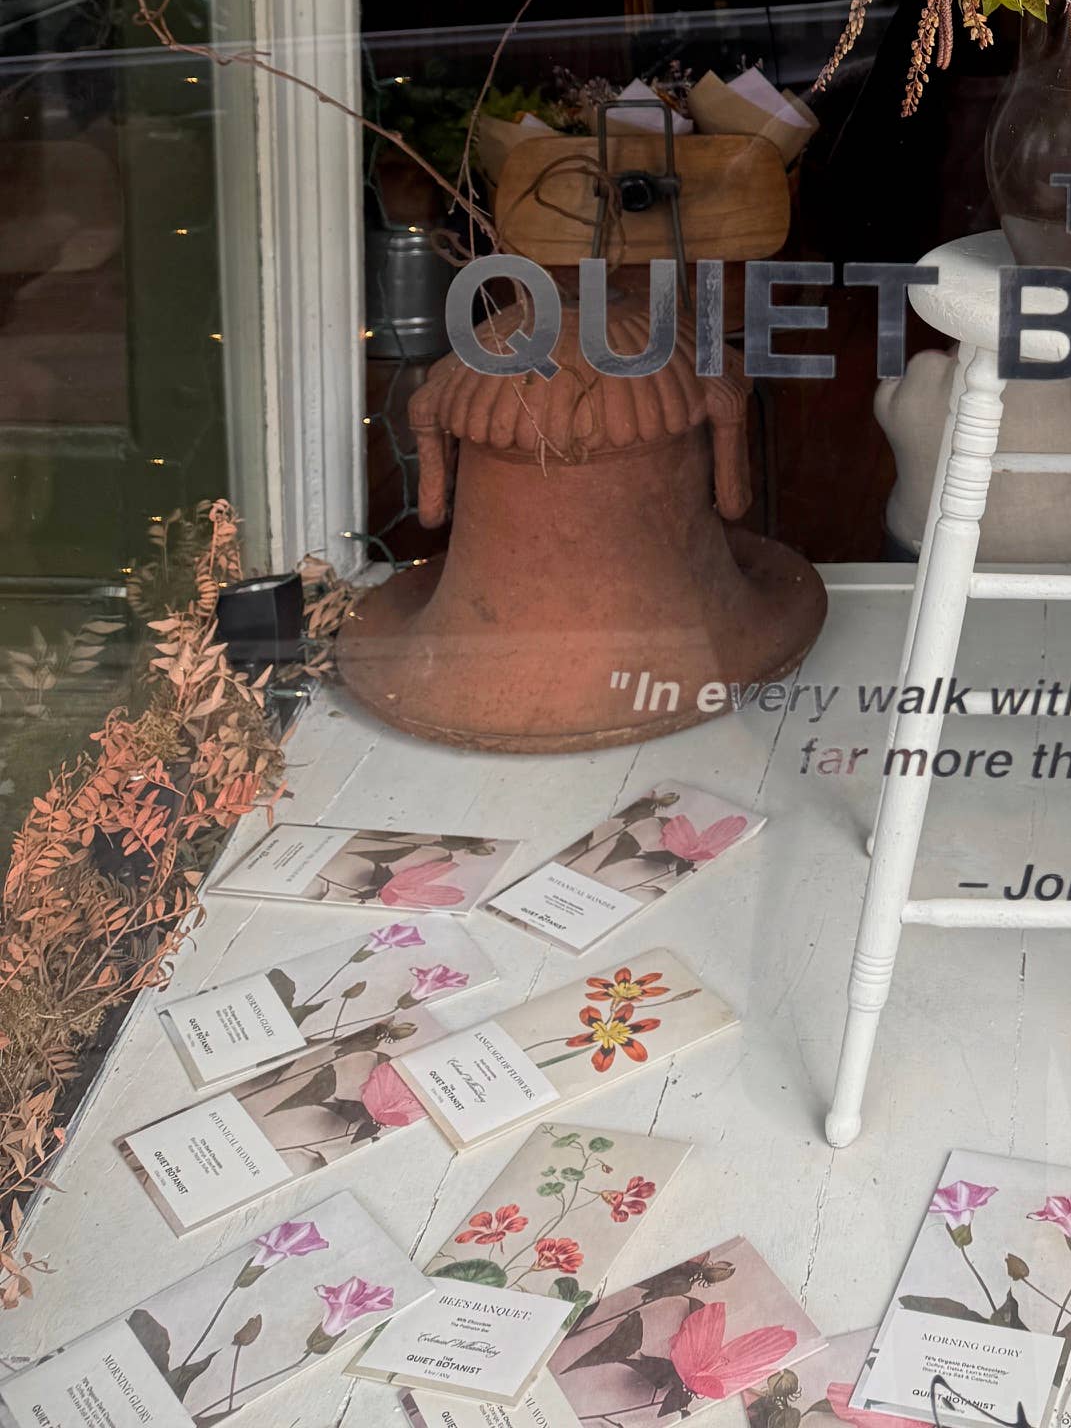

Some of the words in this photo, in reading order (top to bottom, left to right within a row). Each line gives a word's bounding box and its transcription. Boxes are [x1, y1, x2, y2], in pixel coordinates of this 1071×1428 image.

[444, 253, 940, 383] QUIET
[609, 673, 680, 712] "In
[697, 682, 840, 723] every
[857, 676, 972, 715] walk
[799, 737, 869, 776] far
[882, 747, 1014, 779] more
[153, 1150, 171, 1170] QUIET
[165, 1165, 189, 1195] BOTANIST
[406, 1353, 436, 1367] QUIET
[435, 1358, 483, 1375] BOTANIST
[920, 1332, 980, 1351] MORNING
[981, 1344, 1024, 1359] GLORY
[102, 1353, 134, 1397] MORNING
[127, 1390, 154, 1425] GLORY
[912, 1388, 944, 1402] QUIT
